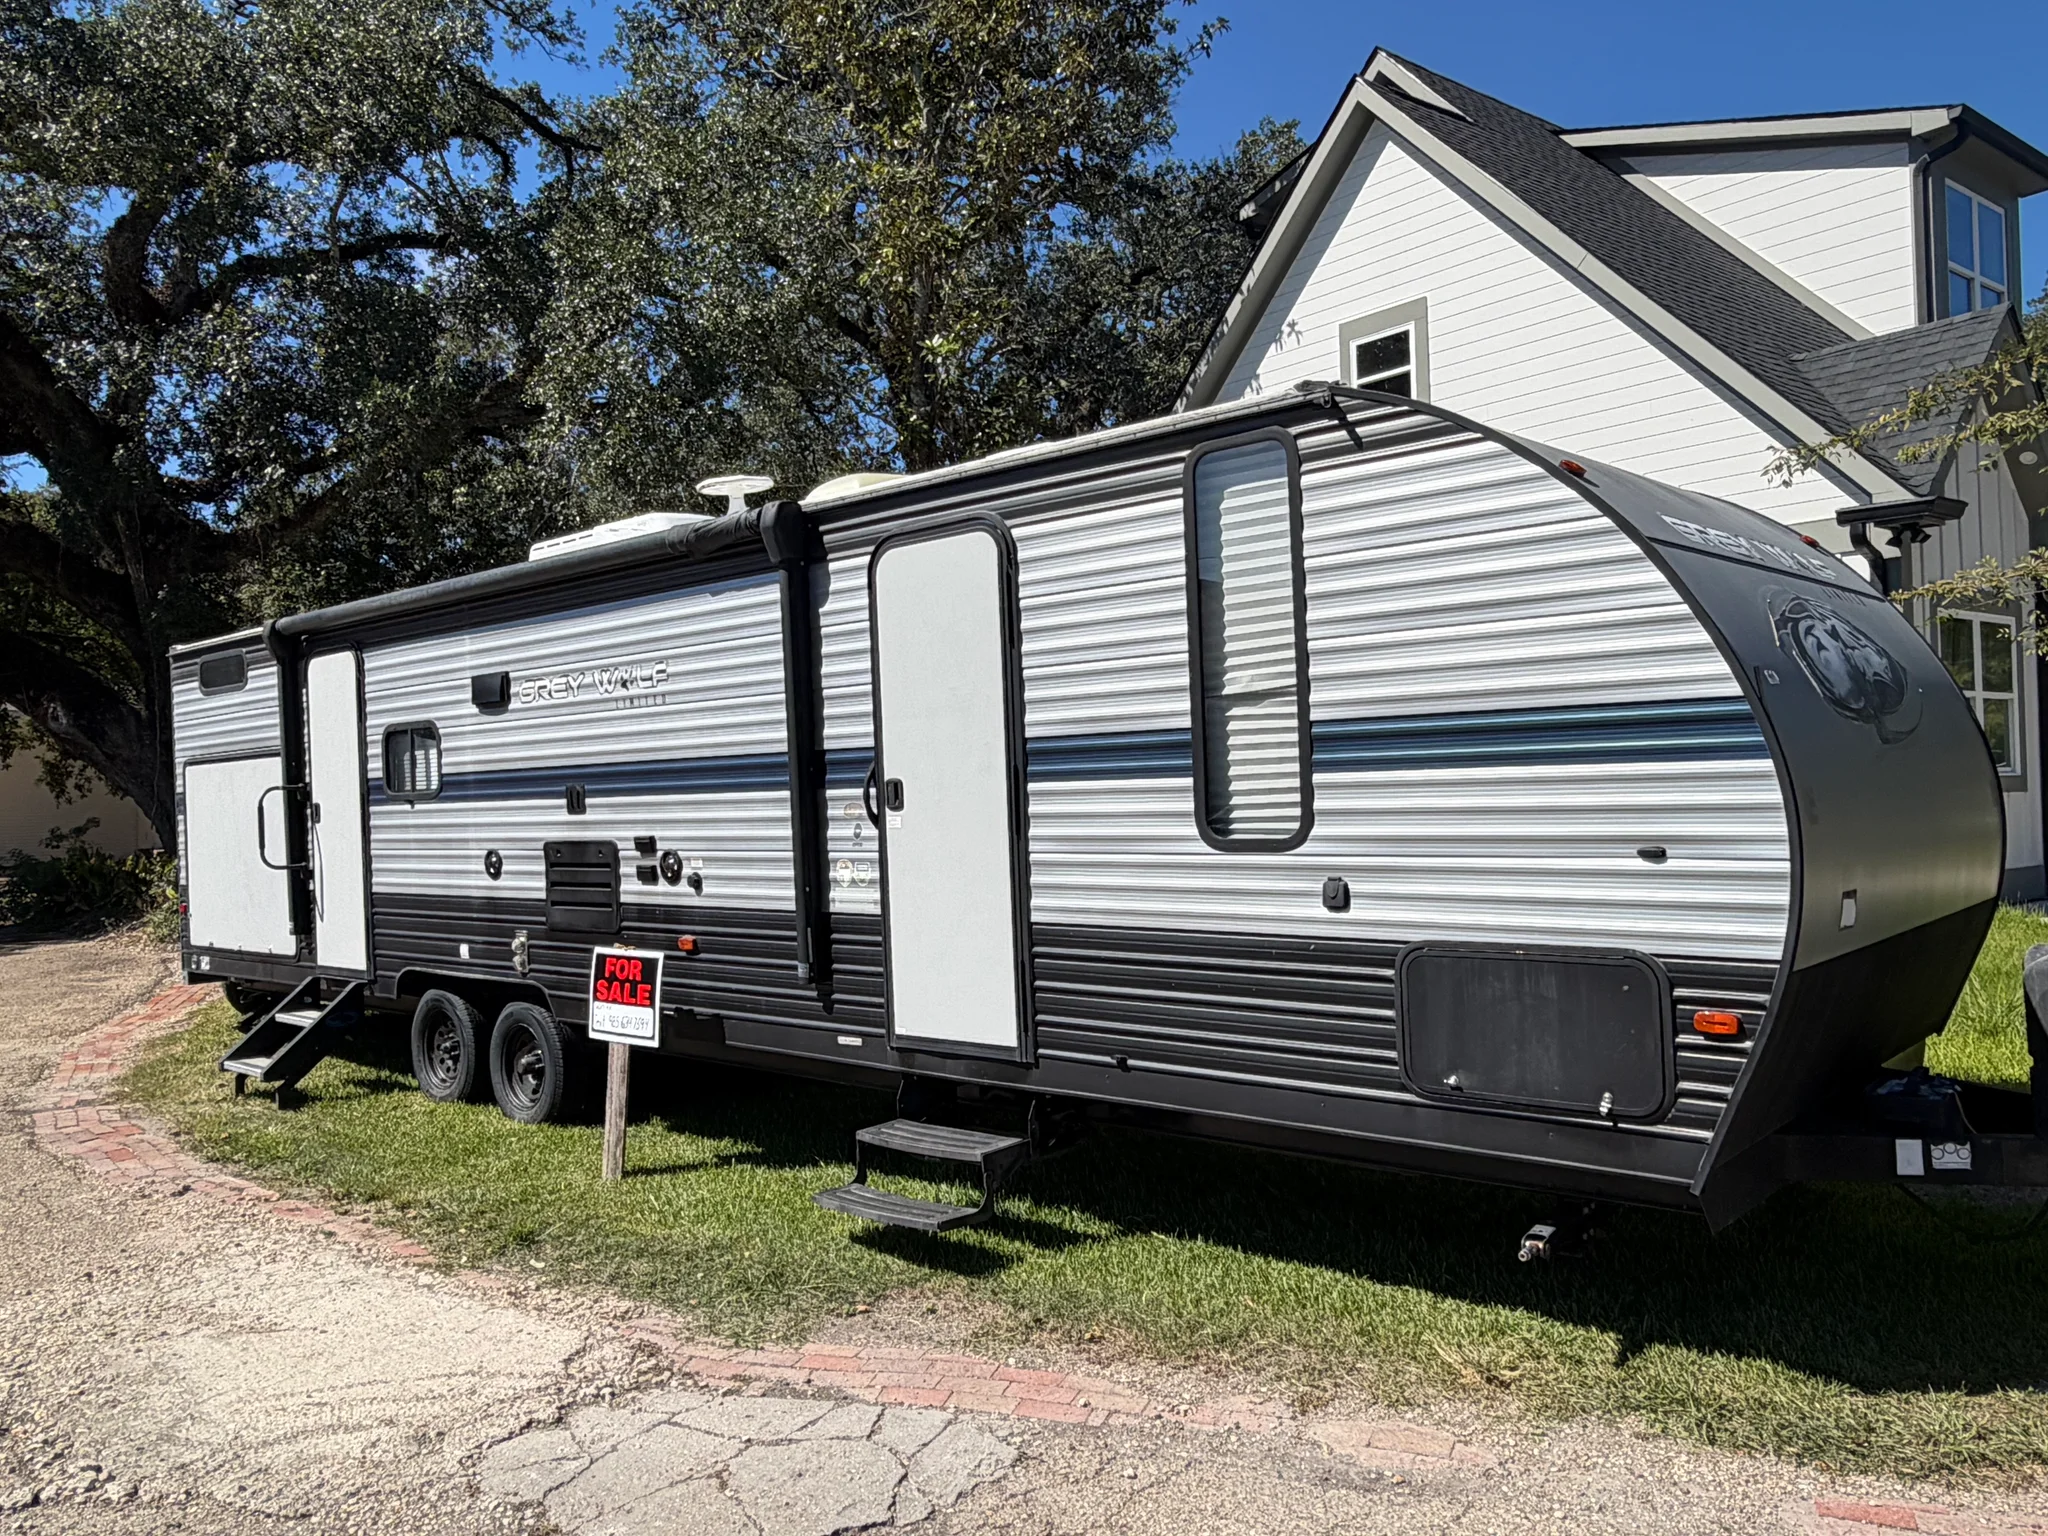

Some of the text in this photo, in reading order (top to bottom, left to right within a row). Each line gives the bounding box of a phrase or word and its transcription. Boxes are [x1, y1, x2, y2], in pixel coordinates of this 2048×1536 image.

[519, 672, 585, 704] GREY
[604, 957, 643, 981] FOR
[596, 979, 652, 1006] SALE
